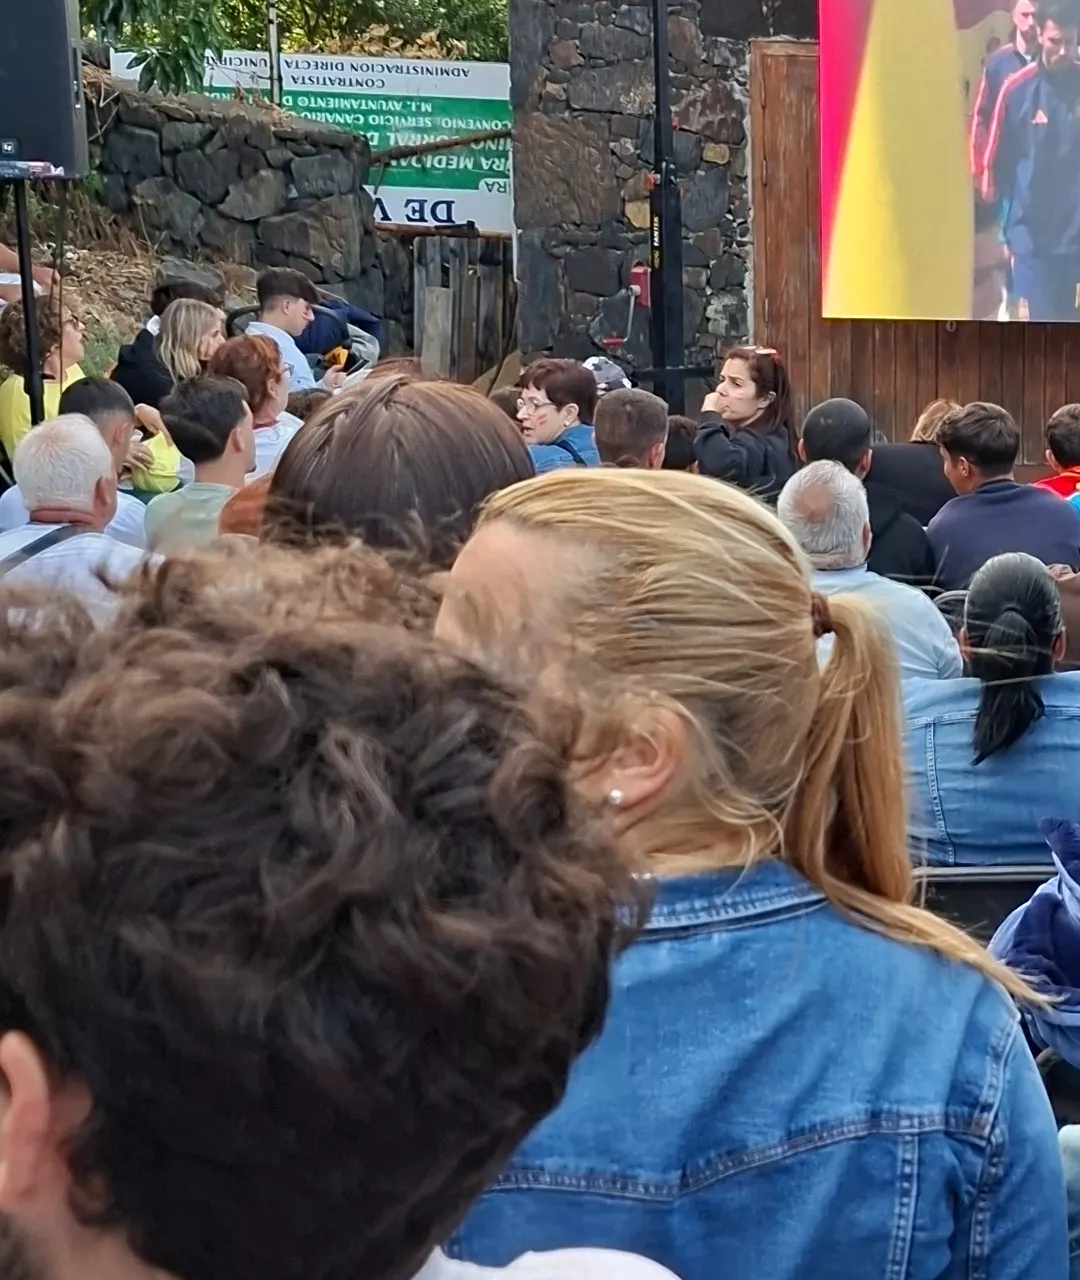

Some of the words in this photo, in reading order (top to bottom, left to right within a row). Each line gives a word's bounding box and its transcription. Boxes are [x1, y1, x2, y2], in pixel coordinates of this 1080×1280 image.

[284, 59, 344, 73] DIRECTA
[350, 61, 470, 78] ADMINISTRACION
[291, 75, 385, 89] CONTRATISTA
[281, 95, 293, 106] D
[297, 96, 402, 111] AYUNTAMIENTO
[368, 114, 432, 127] SERVICIO
[484, 181, 510, 193] RA
[373, 197, 392, 222] V
[403, 199, 456, 224] DE
